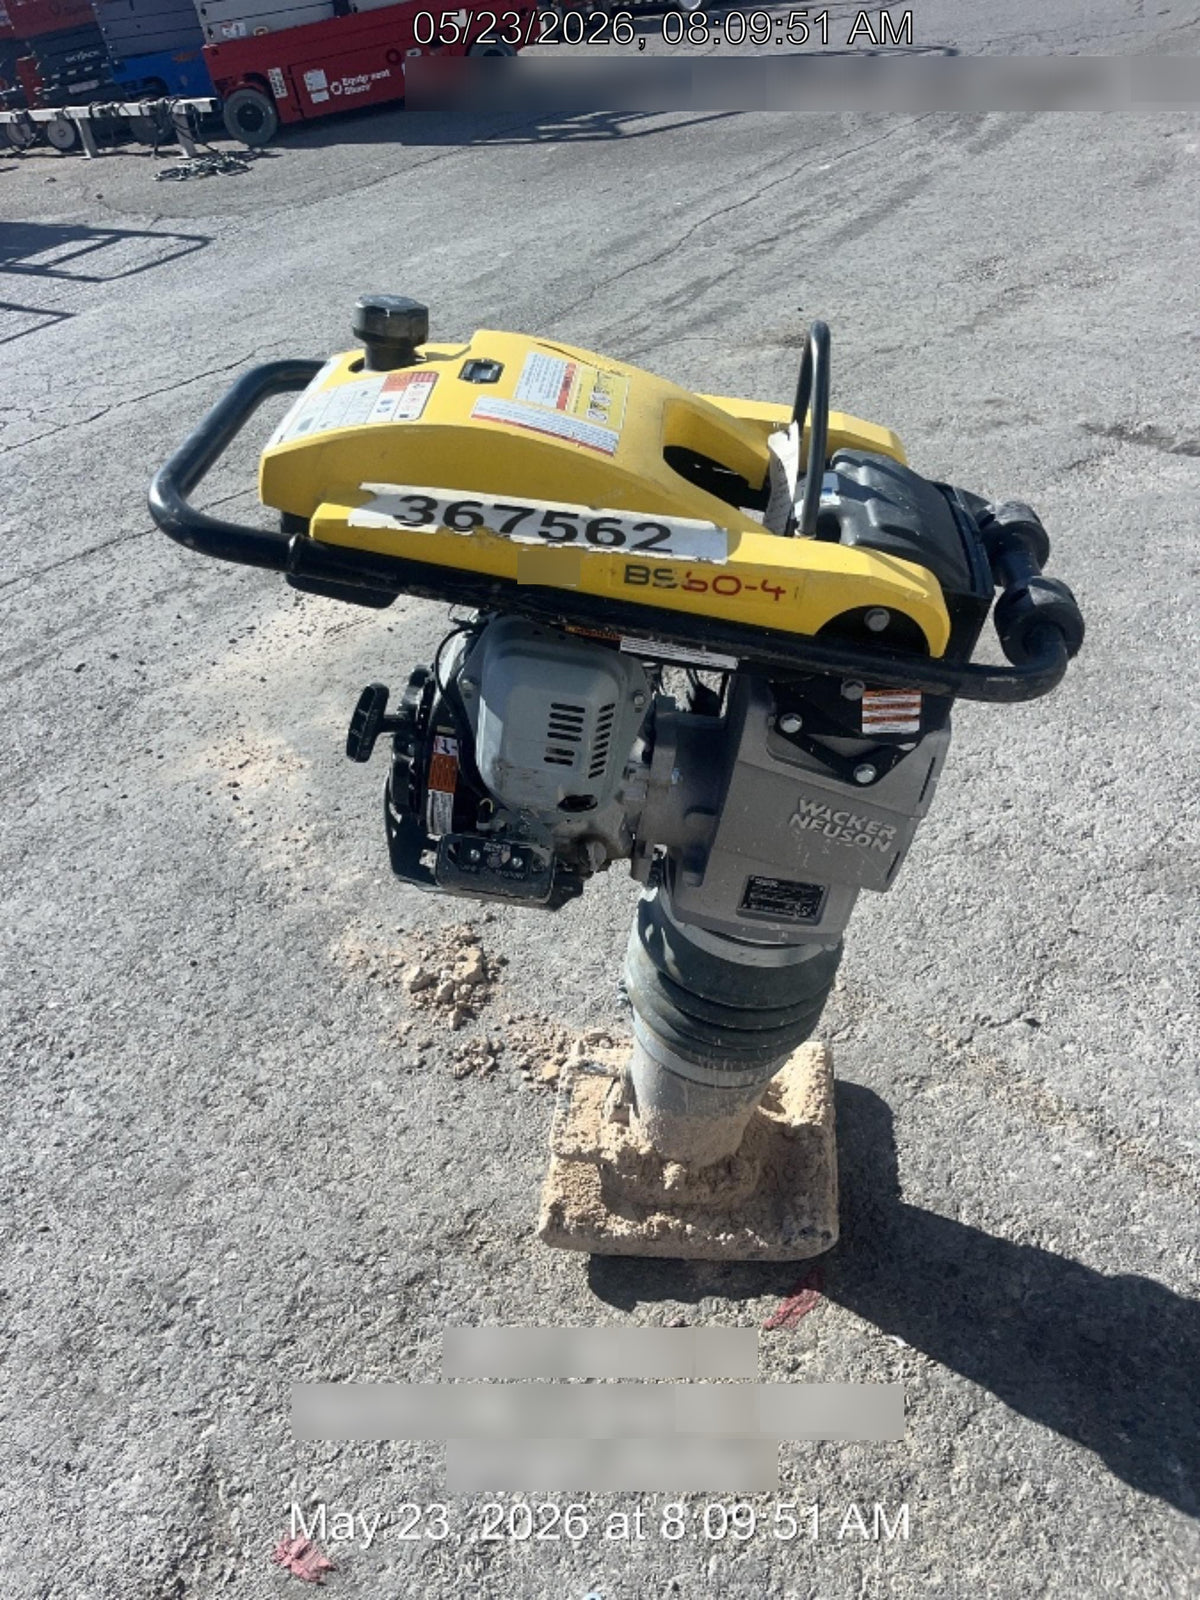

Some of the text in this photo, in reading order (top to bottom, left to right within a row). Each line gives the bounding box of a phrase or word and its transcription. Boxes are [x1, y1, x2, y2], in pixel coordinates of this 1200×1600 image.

[393, 495, 673, 553] 367562
[624, 564, 787, 601] BS60-4
[788, 813, 892, 853] NEUSON
[799, 797, 897, 840] WACKER
